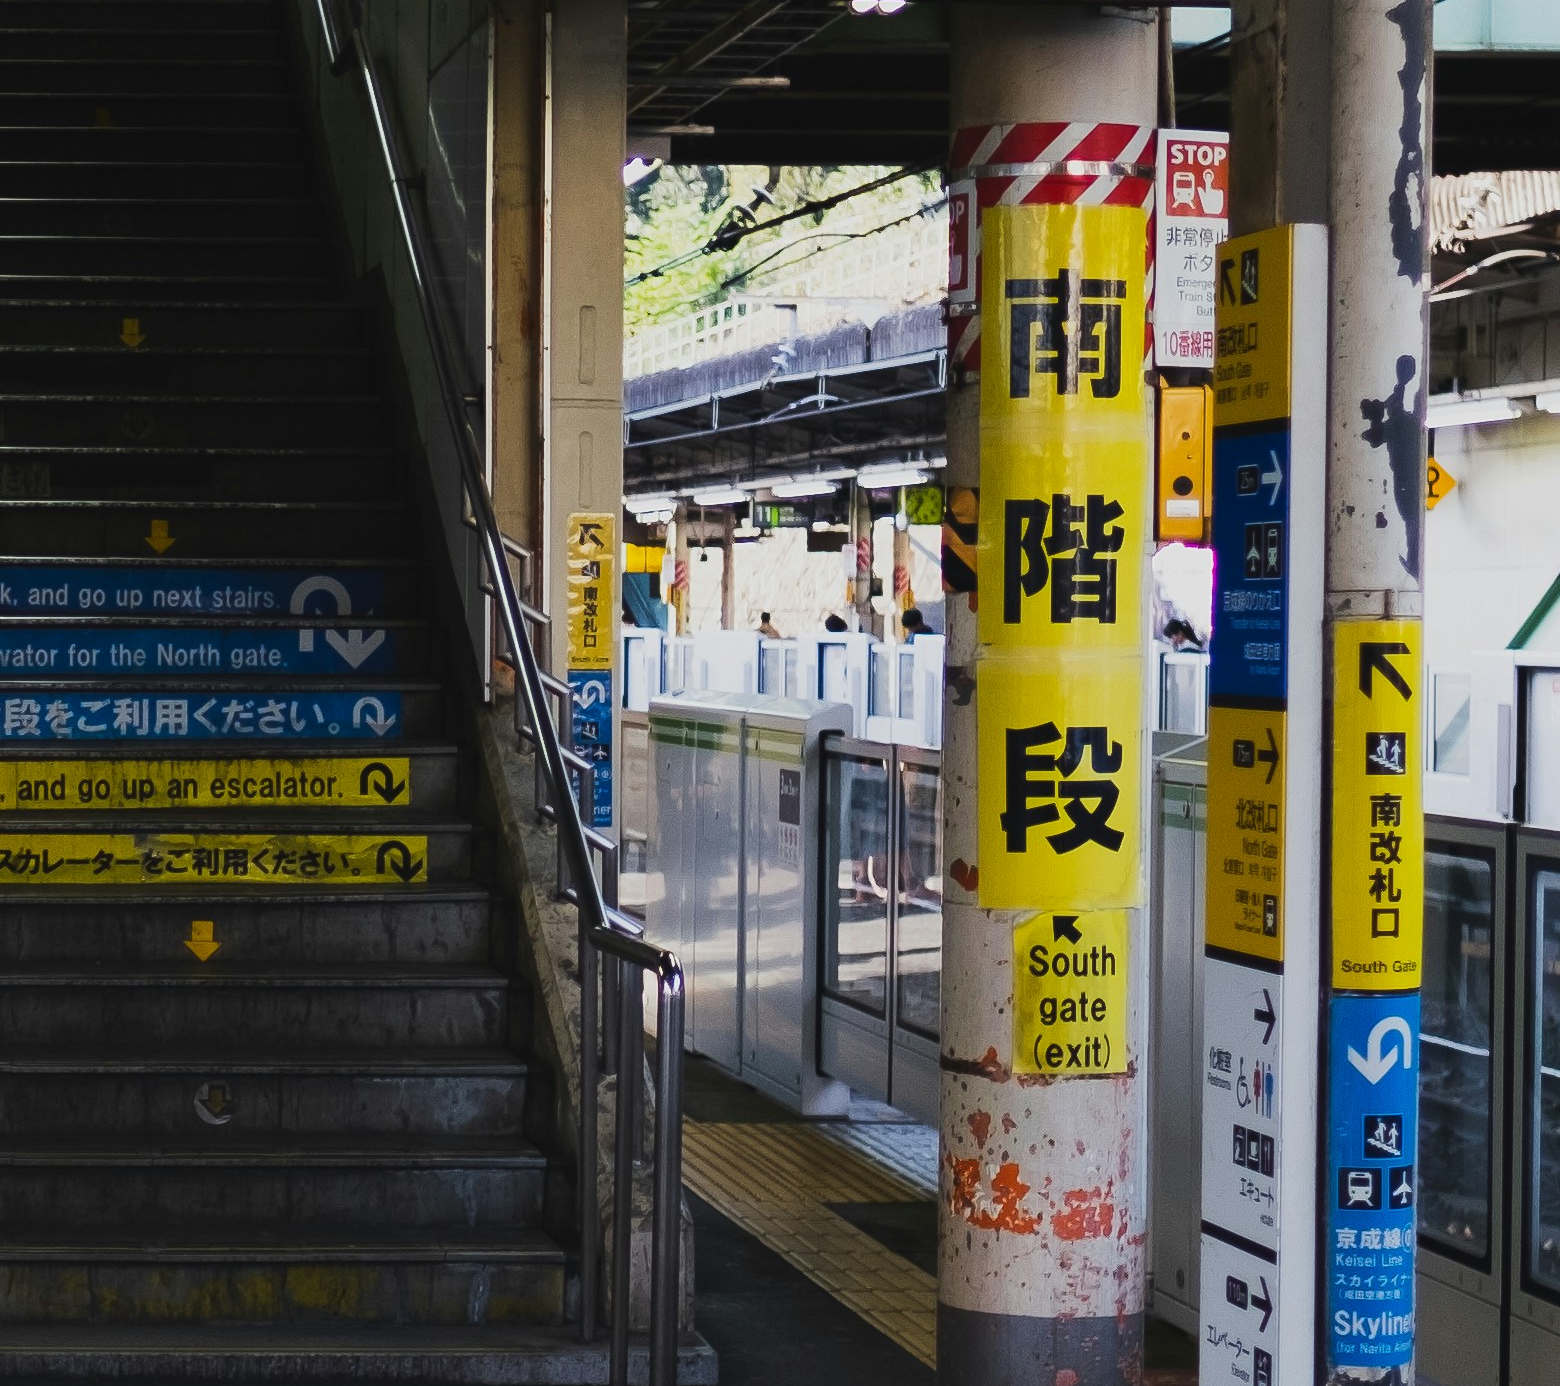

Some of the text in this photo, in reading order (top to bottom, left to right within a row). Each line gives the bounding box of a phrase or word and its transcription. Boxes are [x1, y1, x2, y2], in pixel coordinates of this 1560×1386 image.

[1171, 144, 1227, 166] STOP
[1179, 290, 1204, 303] Train
[1162, 330, 1213, 359] 10番線用
[1000, 273, 1126, 857] 南階段
[28, 585, 69, 607] and
[78, 589, 106, 611] go
[115, 590, 143, 611] up
[153, 588, 202, 608] next
[211, 585, 282, 610] stairs.
[583, 585, 599, 648] 南改札口
[68, 644, 100, 667] for
[110, 644, 146, 667] the
[157, 645, 220, 668] North
[230, 647, 287, 672] gate.
[17, 774, 67, 801] and
[78, 777, 110, 804] go
[119, 777, 154, 804] up
[168, 776, 198, 800] an
[209, 770, 344, 799] escalator.
[1368, 792, 1403, 939] 南改札口
[1029, 944, 1116, 977] South
[1341, 959, 1388, 973] South
[1039, 991, 1107, 1026] gate
[1033, 1033, 1111, 1070] (exit)
[1334, 1227, 1402, 1250] 京成線
[1335, 1253, 1403, 1267] Keisei Line
